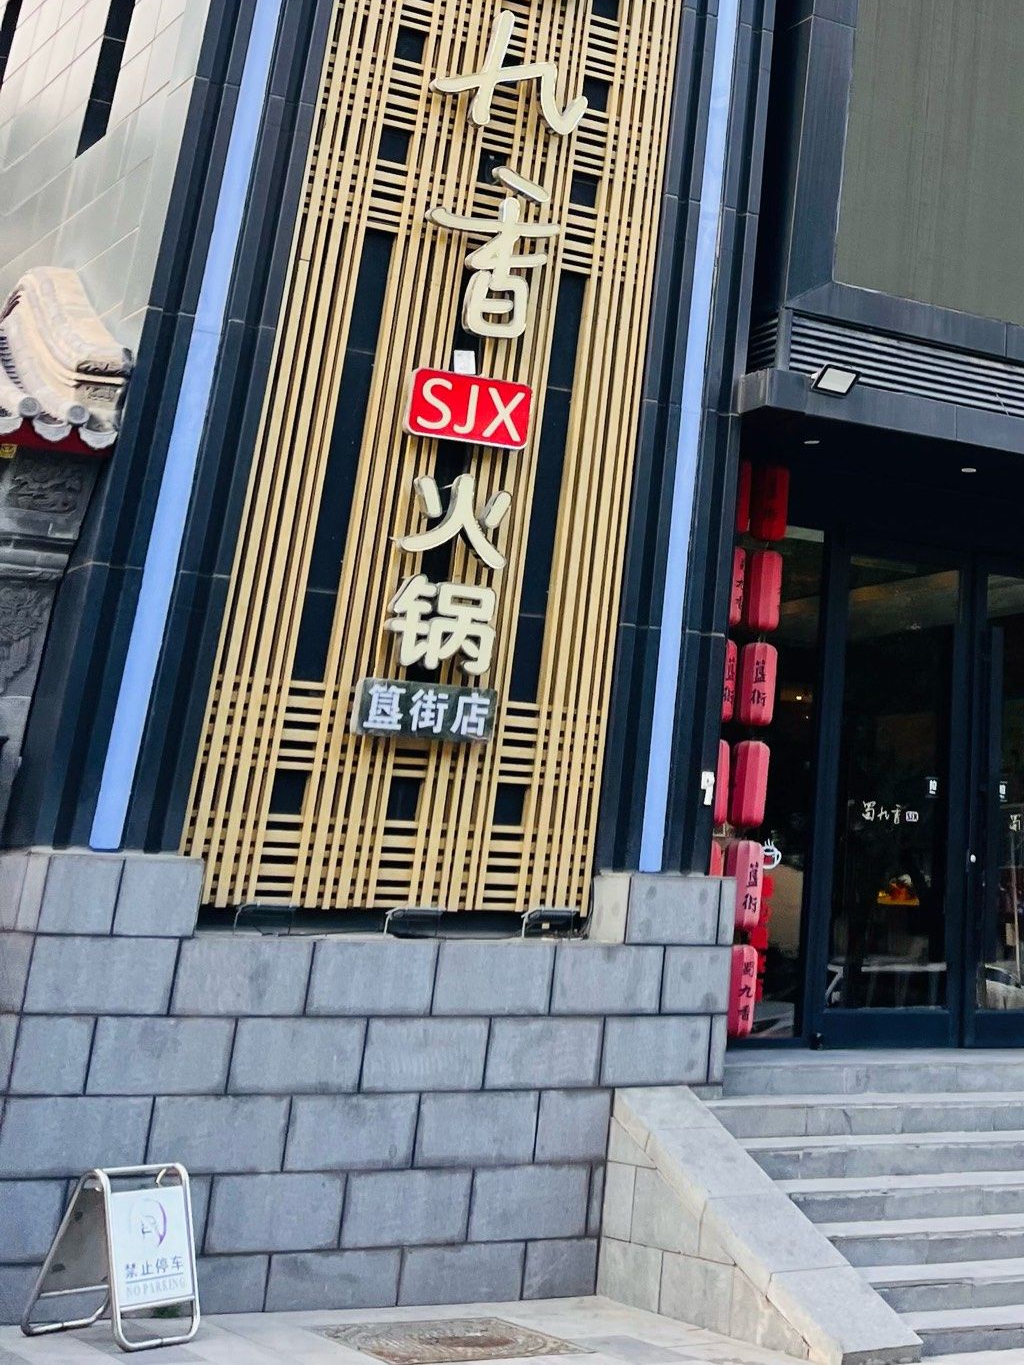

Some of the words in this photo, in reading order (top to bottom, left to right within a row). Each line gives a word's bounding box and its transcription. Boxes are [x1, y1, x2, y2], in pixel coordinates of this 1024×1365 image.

[415, 376, 527, 443] SJX
[385, 472, 513, 677] 火锅
[362, 682, 491, 737] 簋街店
[125, 1254, 184, 1279] 禁止停车
[126, 1284, 141, 1299] NO
[143, 1276, 187, 1295] PARKING
